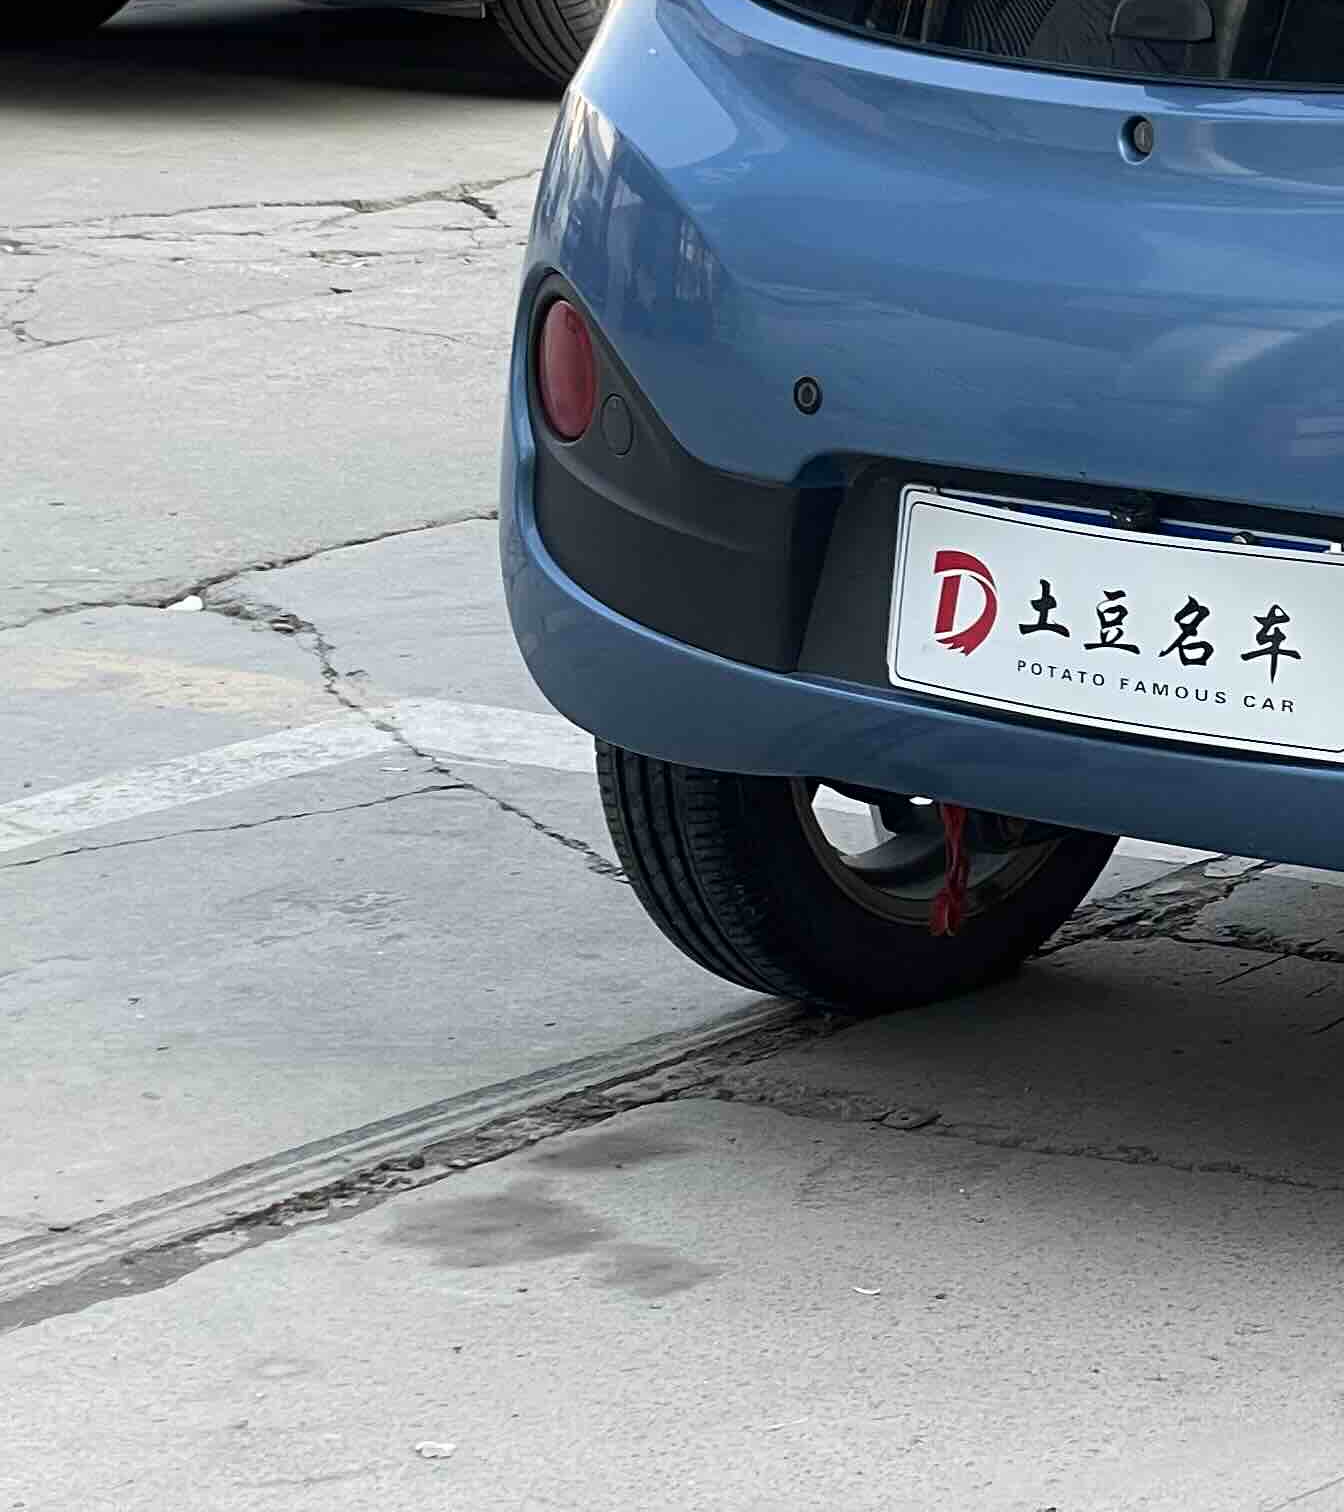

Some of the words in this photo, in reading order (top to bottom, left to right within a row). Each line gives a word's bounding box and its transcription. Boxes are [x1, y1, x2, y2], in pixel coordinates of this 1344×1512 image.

[1018, 579, 1302, 684] 土豆名车
[1017, 660, 1106, 687] POTATO
[1120, 678, 1227, 705] FAMOUS
[1243, 694, 1295, 714] CAR
